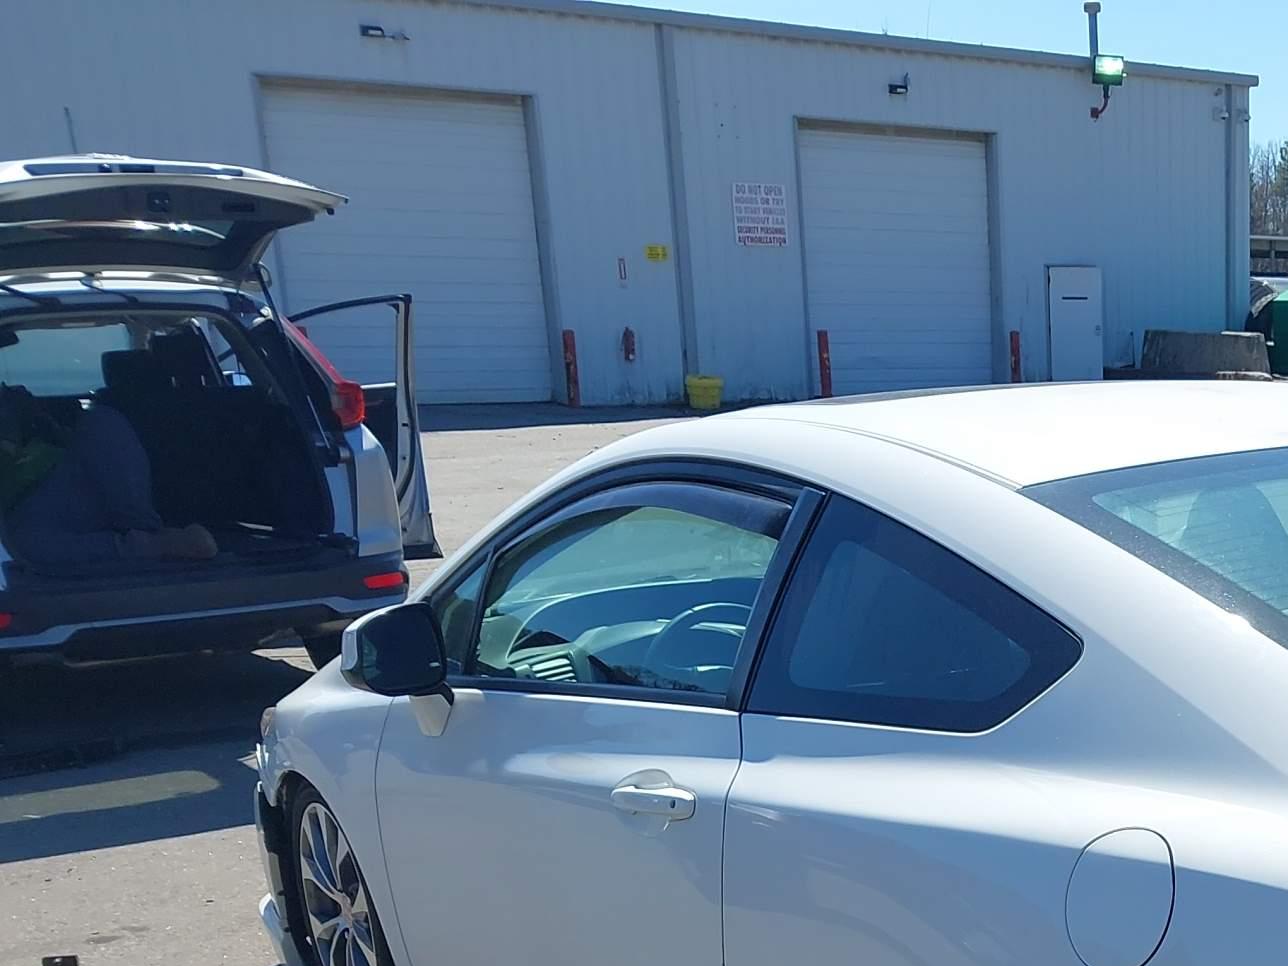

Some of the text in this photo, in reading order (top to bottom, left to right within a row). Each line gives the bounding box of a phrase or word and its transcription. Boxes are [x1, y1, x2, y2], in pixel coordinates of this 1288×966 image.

[736, 184, 783, 196] DO NOT OPEN
[760, 197, 770, 205] OR
[736, 216, 769, 224] WITHOUT
[737, 226, 759, 234] SECURITY
[738, 235, 787, 244] AUTHORIZATION
